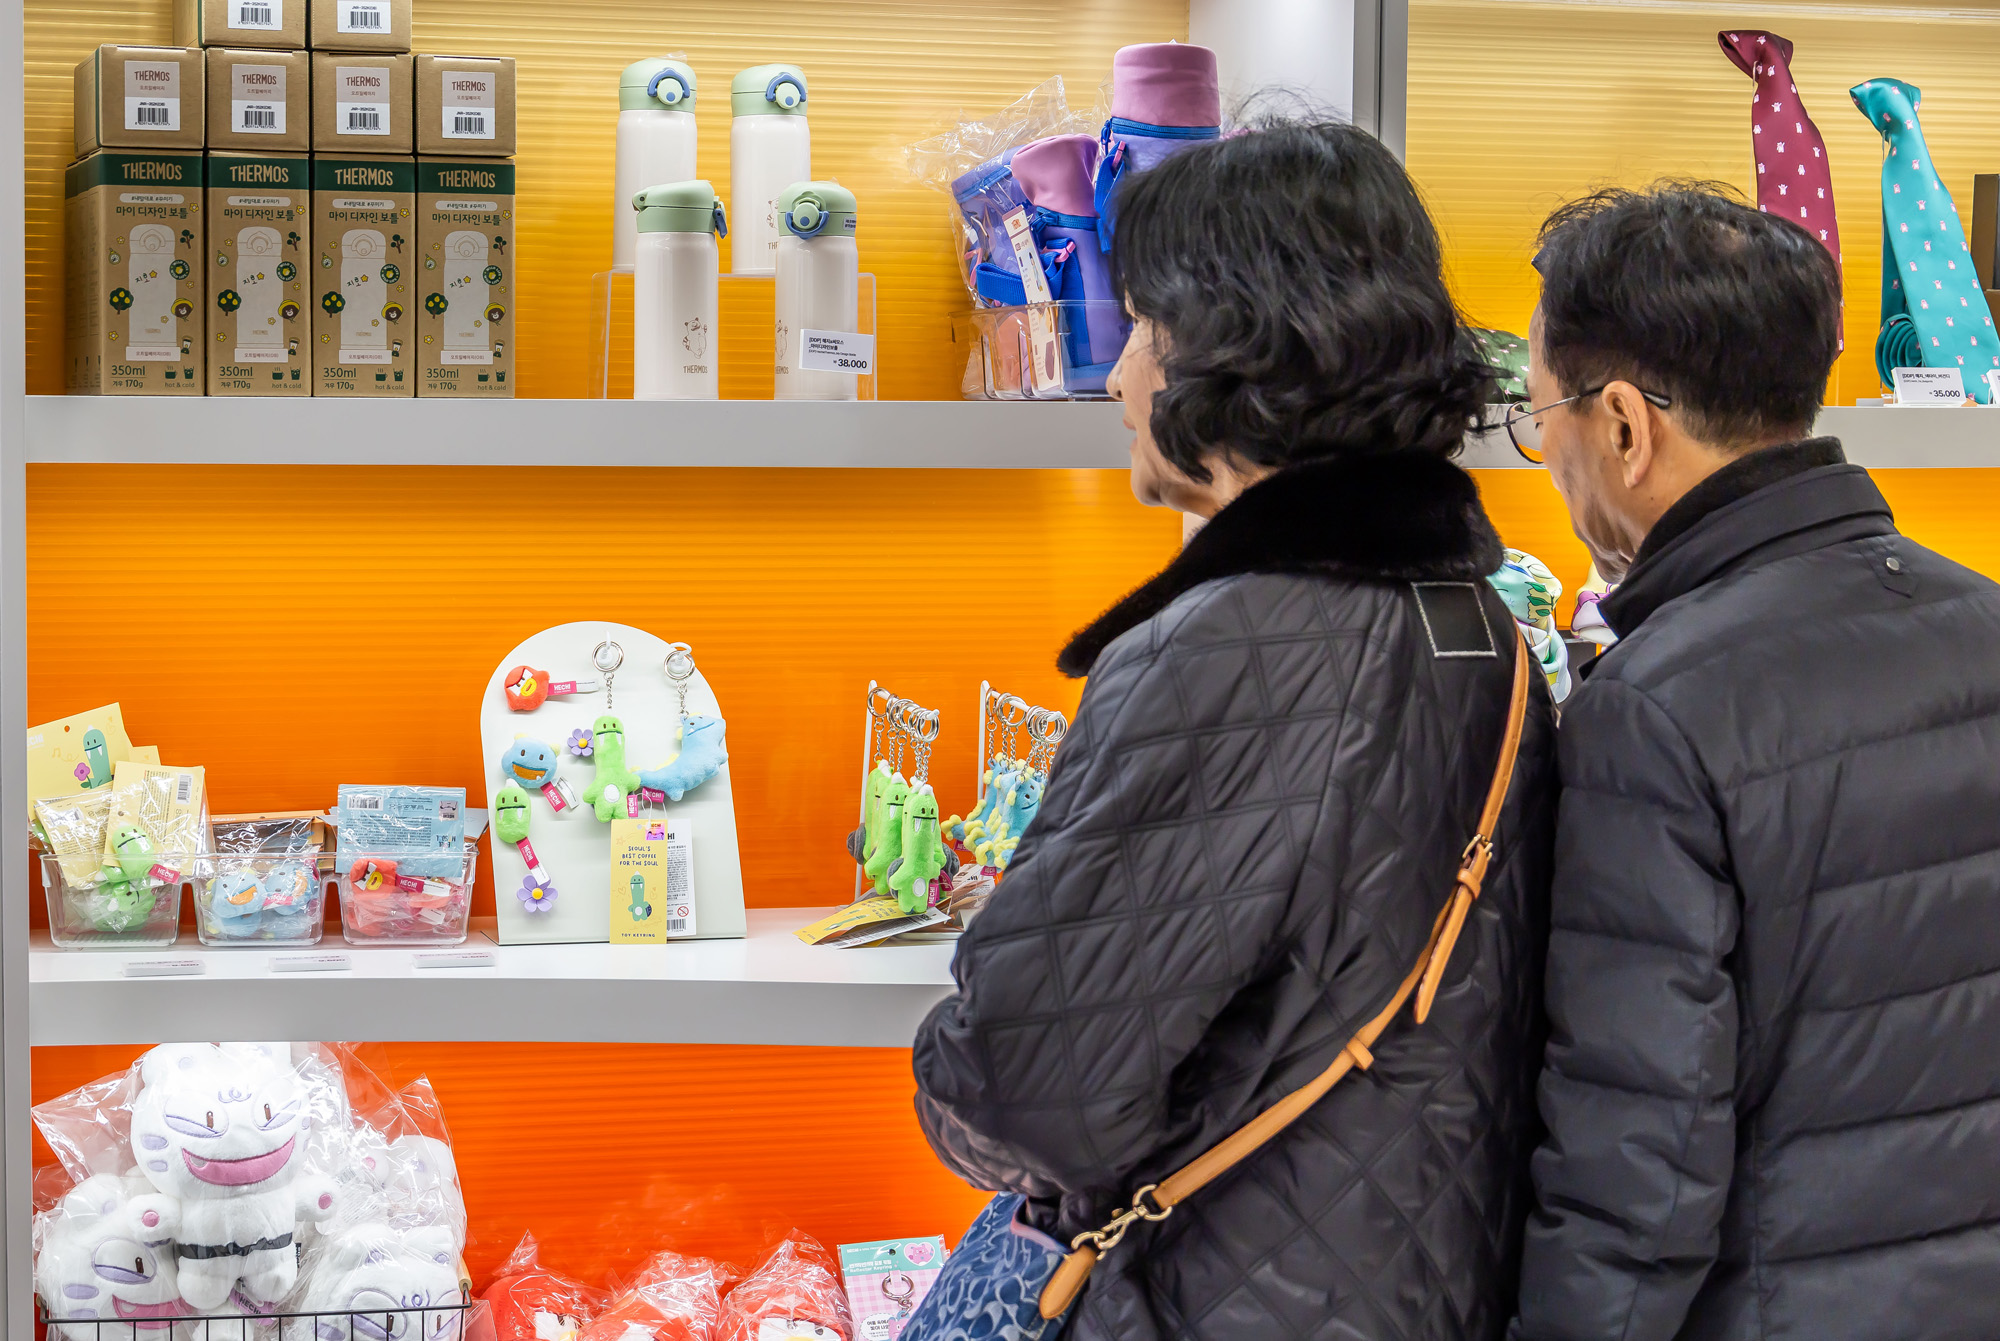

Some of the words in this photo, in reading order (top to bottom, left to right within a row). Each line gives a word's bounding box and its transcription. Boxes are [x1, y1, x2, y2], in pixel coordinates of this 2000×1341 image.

[134, 70, 170, 81] THERMOS
[242, 74, 277, 85] THERMOS
[346, 76, 381, 87] THERMOS
[452, 81, 486, 92] THERMOS
[122, 162, 182, 180] THERMOS
[229, 164, 289, 183] THERMOS
[335, 168, 393, 186] THERMOS
[438, 170, 496, 188] THERMOS
[116, 206, 135, 216] 마이
[138, 207, 166, 218] 디자인
[169, 208, 188, 219] 보틀
[224, 209, 243, 218] 마이
[245, 209, 274, 221] 디자인
[276, 210, 295, 221] 보틀
[329, 211, 348, 221] 마이
[350, 212, 378, 224] 디자인
[380, 213, 399, 224] 보틀
[432, 213, 451, 223] 마이
[453, 213, 480, 226] 디자인
[482, 214, 501, 226] 보틀
[111, 365, 145, 376] 350ml
[219, 366, 253, 377] 350ml
[323, 368, 356, 378] 350ml
[426, 368, 459, 379] 350ml
[683, 365, 708, 373] THERMOS
[125, 380, 143, 388] 170g
[233, 380, 250, 389] 170g
[337, 382, 354, 391] 170g
[440, 382, 457, 391] 170g
[549, 789, 561, 805] HECHI
[524, 845, 534, 861] HECHI
[158, 868, 175, 879] HECHI
[400, 879, 417, 888] HECHI
